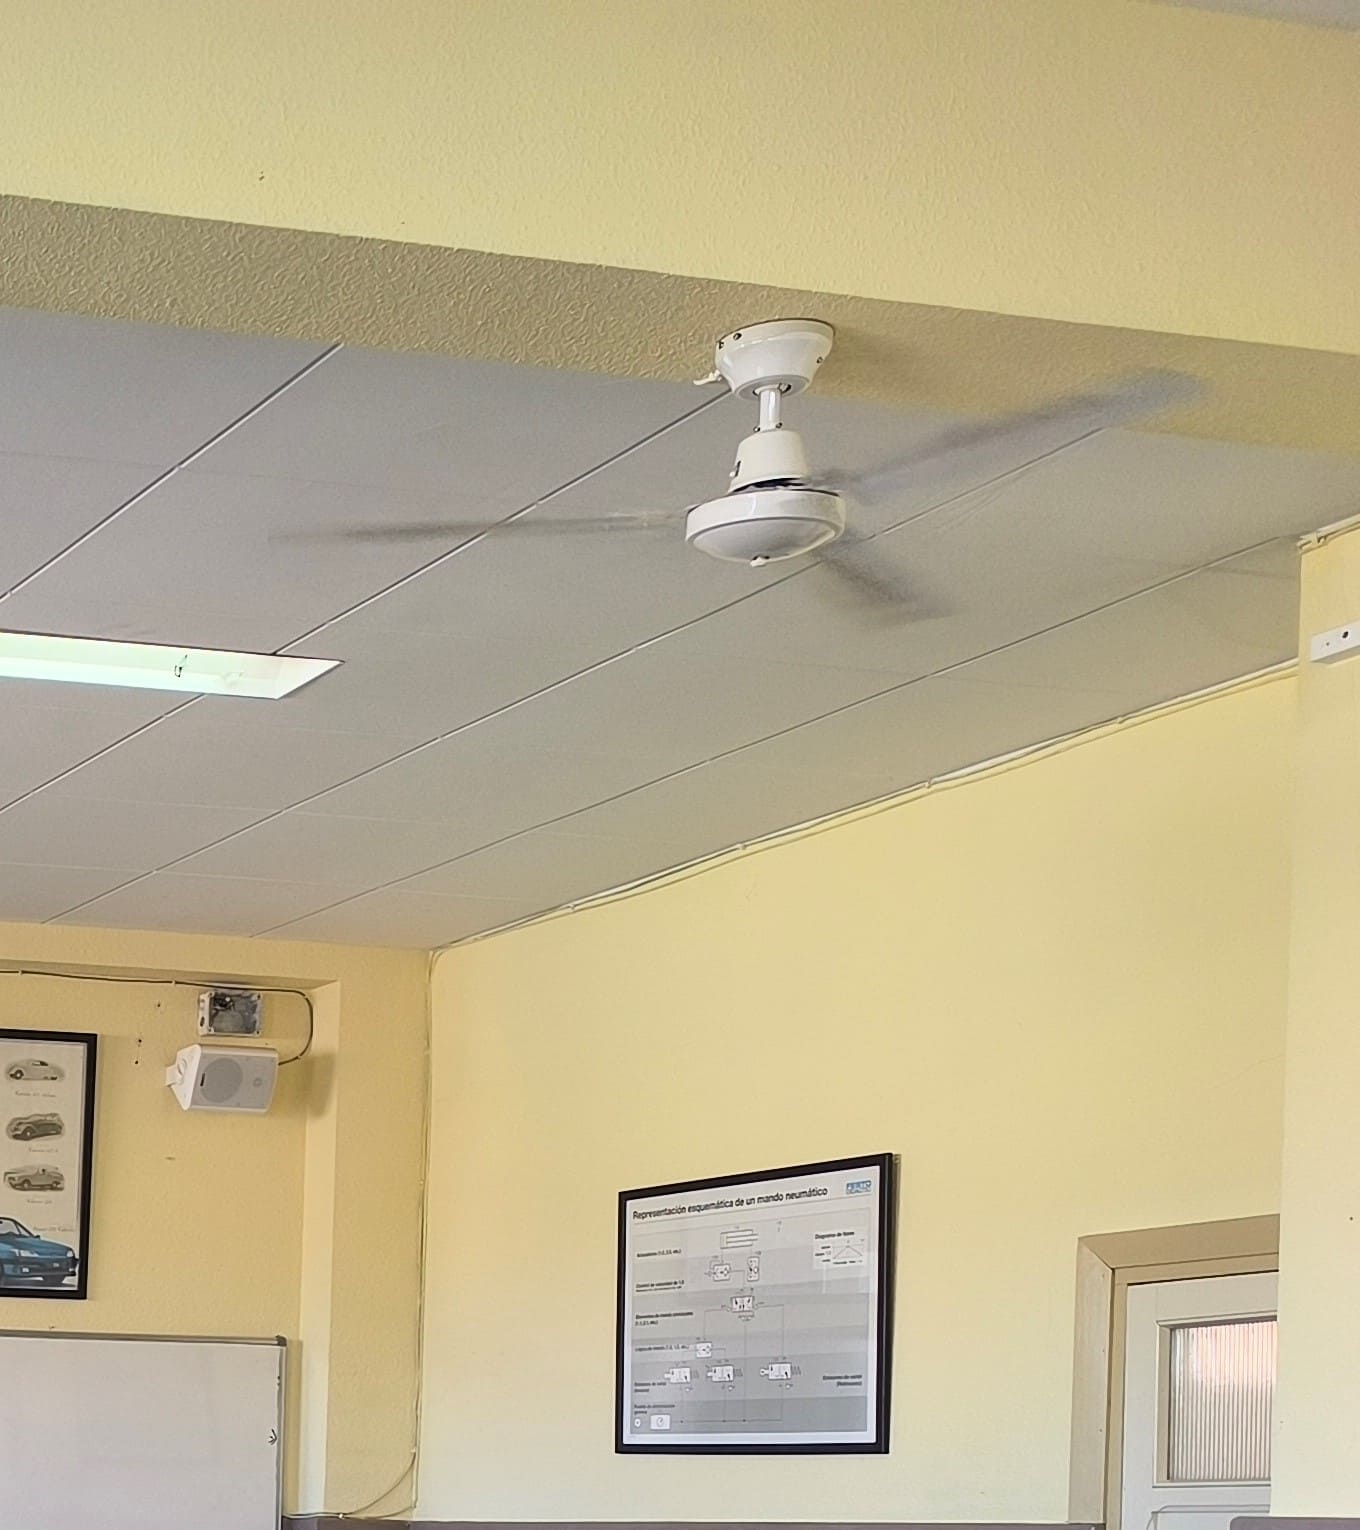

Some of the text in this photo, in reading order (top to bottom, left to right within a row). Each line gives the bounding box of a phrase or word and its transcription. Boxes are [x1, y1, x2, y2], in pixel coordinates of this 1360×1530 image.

[632, 1185, 828, 1220] Representación esquemática de un mando neumático
